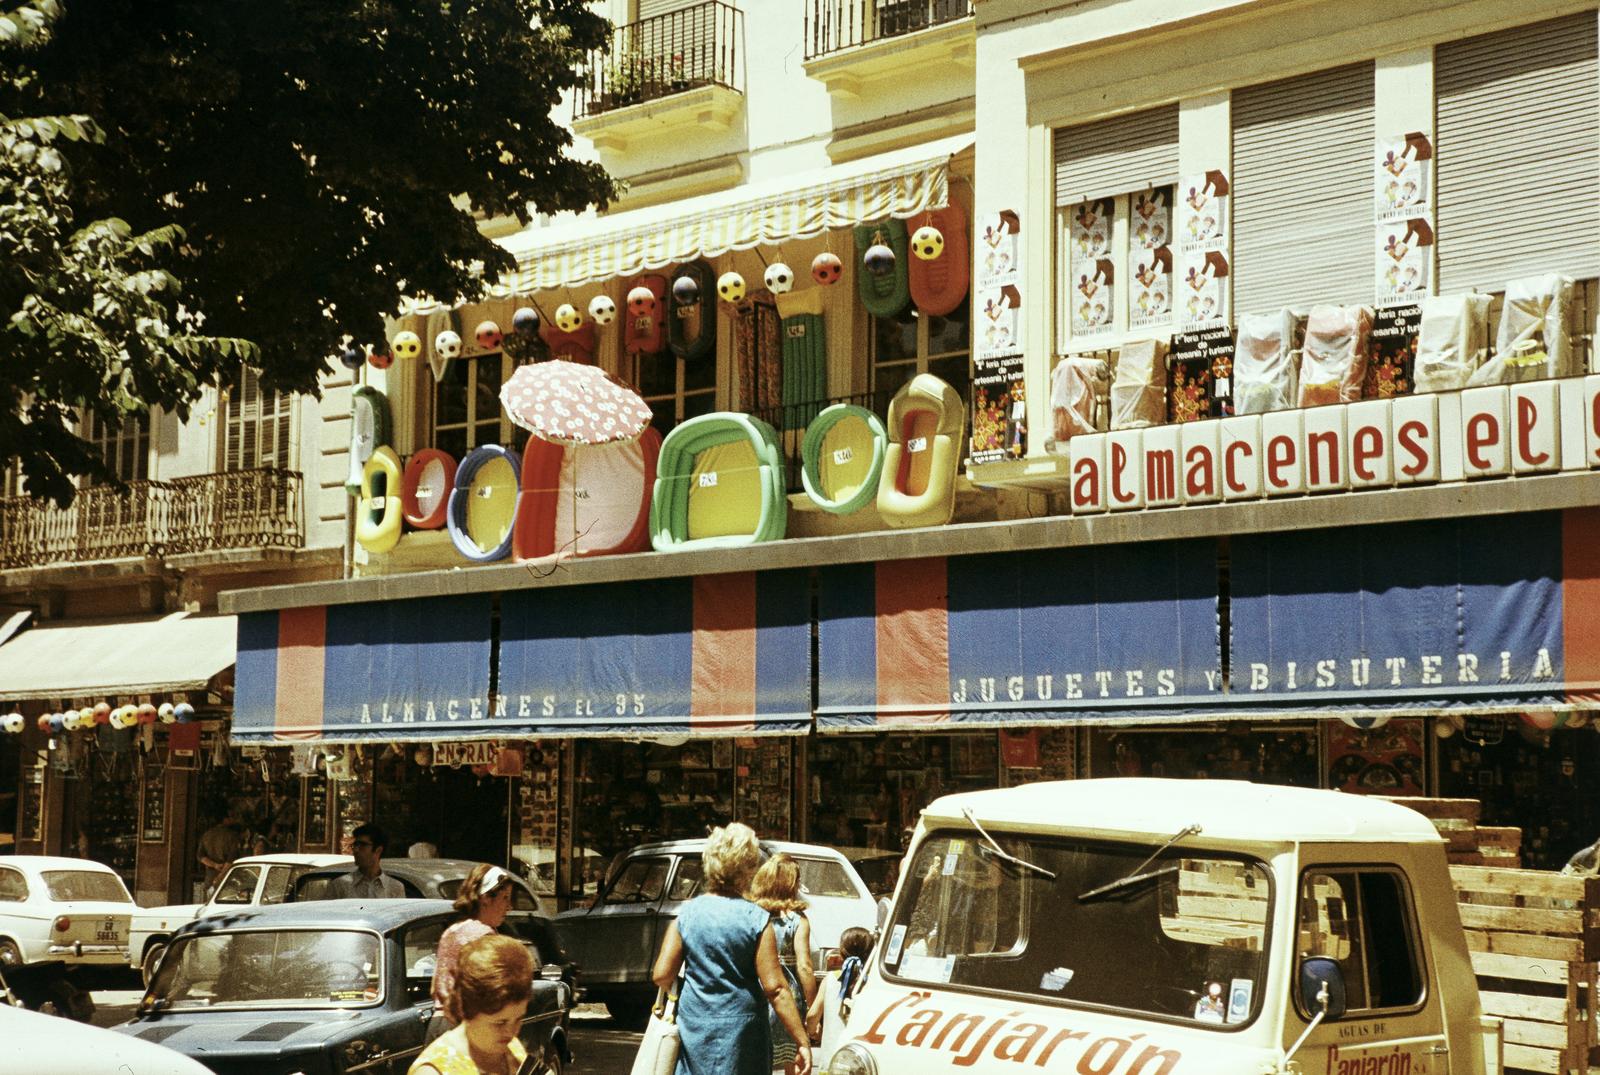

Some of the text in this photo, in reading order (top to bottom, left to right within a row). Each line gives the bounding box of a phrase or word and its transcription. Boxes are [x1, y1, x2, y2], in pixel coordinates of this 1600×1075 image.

[1197, 341, 1208, 349] de
[1202, 350, 1208, 358] y
[998, 367, 1007, 375] de
[1074, 420, 1429, 507] almacenes
[1467, 395, 1549, 471] el
[952, 648, 1554, 704] JUGUETES Y BISUTERIA
[360, 694, 645, 724] ALMACENES EL 95
[1339, 1023, 1386, 1038] AGUAS DE
